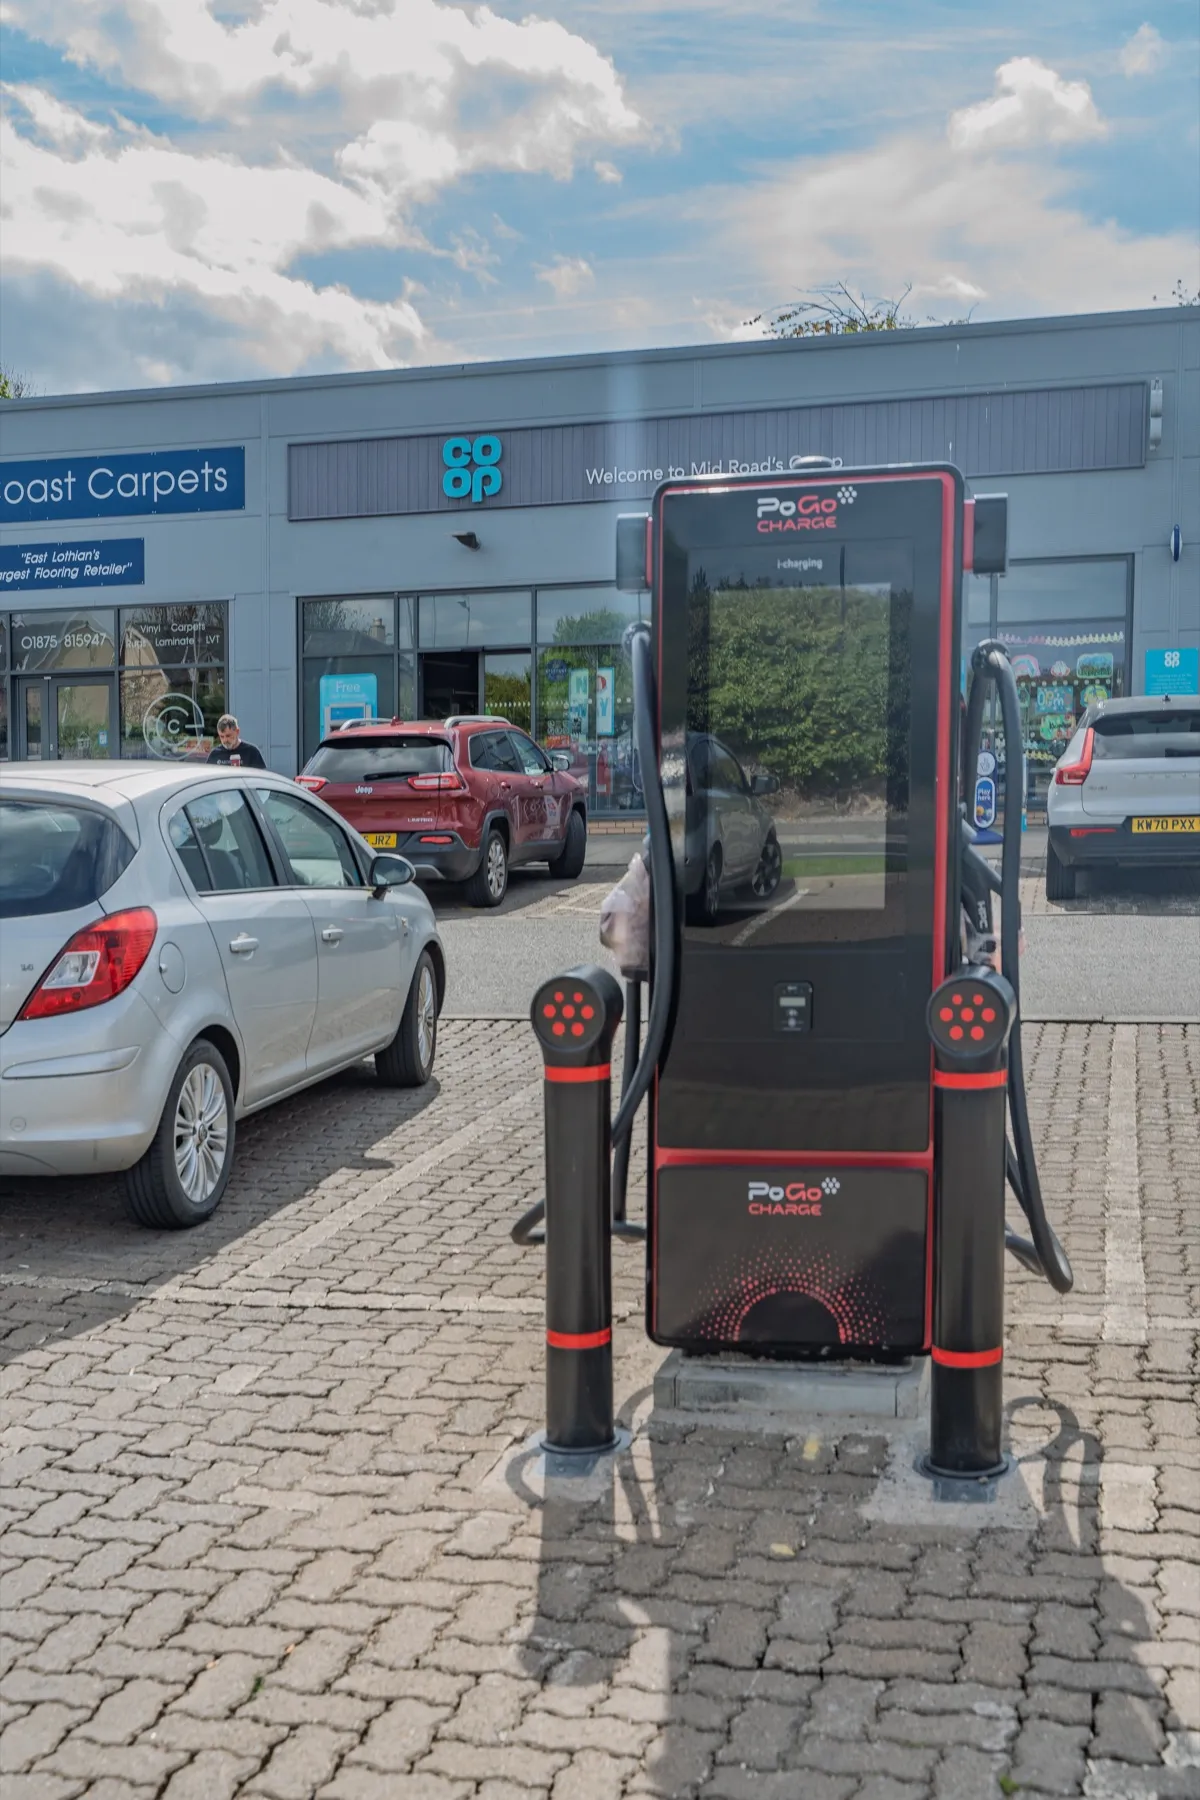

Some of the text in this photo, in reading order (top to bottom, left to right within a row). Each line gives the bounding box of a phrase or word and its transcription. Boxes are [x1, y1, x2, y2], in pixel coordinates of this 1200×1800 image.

[586, 466, 663, 485] Welcome
[668, 466, 685, 478] to
[691, 460, 723, 475] Mid
[729, 456, 784, 473] Road's
[0, 461, 228, 504] oast Carpets
[757, 495, 838, 518] PoGo
[757, 516, 837, 533] CHARGE
[21, 549, 100, 564] "East Lothian's
[0, 562, 133, 583] argest Flooring Retailer"
[140, 623, 206, 634] Vinyl Carpets
[21, 632, 107, 649] 01875 815947
[155, 636, 195, 647] Laminate
[205, 634, 220, 644] LVT
[335, 680, 361, 693] Free
[355, 785, 373, 794] Jeep
[977, 788, 991, 796] Play
[1137, 819, 1195, 831] KW70 PXX
[371, 834, 392, 845] JRZ
[976, 900, 989, 930] HPC
[748, 1181, 823, 1202] PoGo
[748, 1202, 823, 1217] CHARGE
